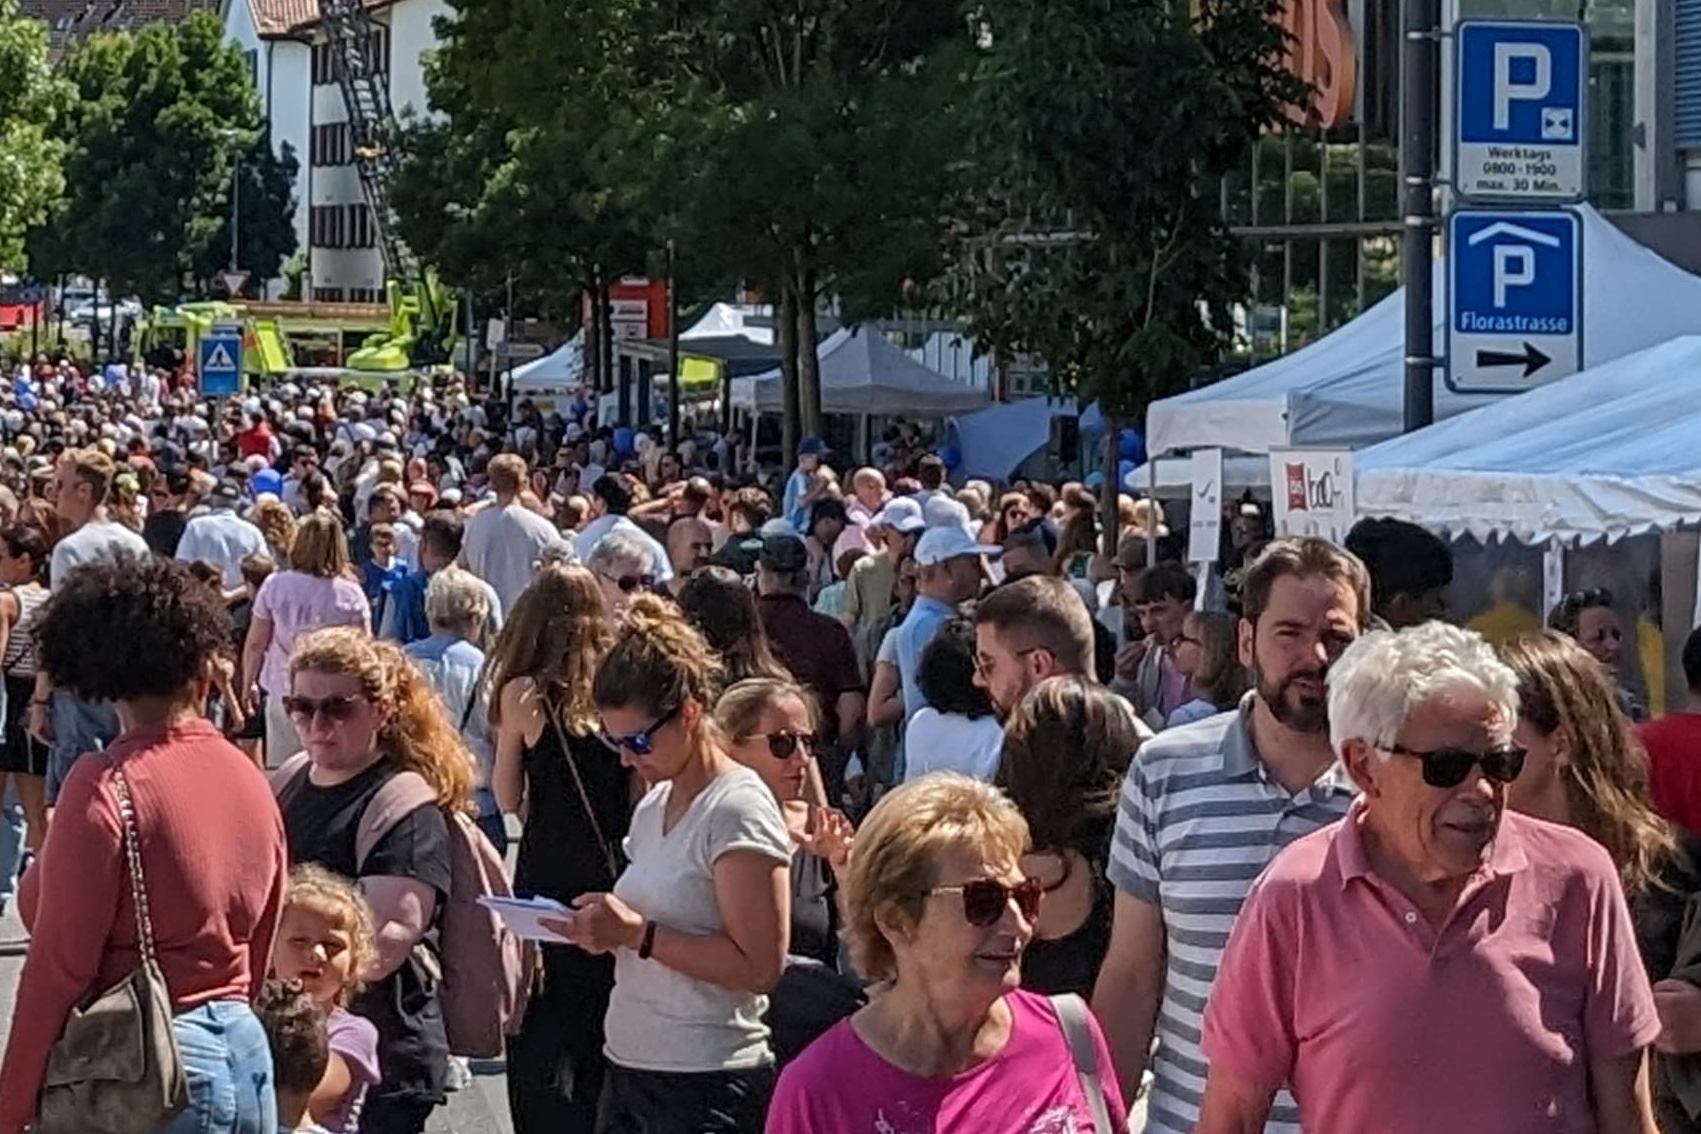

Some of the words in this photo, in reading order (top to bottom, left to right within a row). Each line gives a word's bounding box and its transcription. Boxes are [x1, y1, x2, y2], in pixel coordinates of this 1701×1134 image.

[1493, 41, 1552, 130] P
[1487, 146, 1552, 162] Werktags
[1476, 179, 1507, 191] max.
[1512, 178, 1529, 191] 30
[1533, 179, 1562, 192] Min.
[1493, 244, 1536, 308] P
[1460, 311, 1567, 332] Florastrasse
